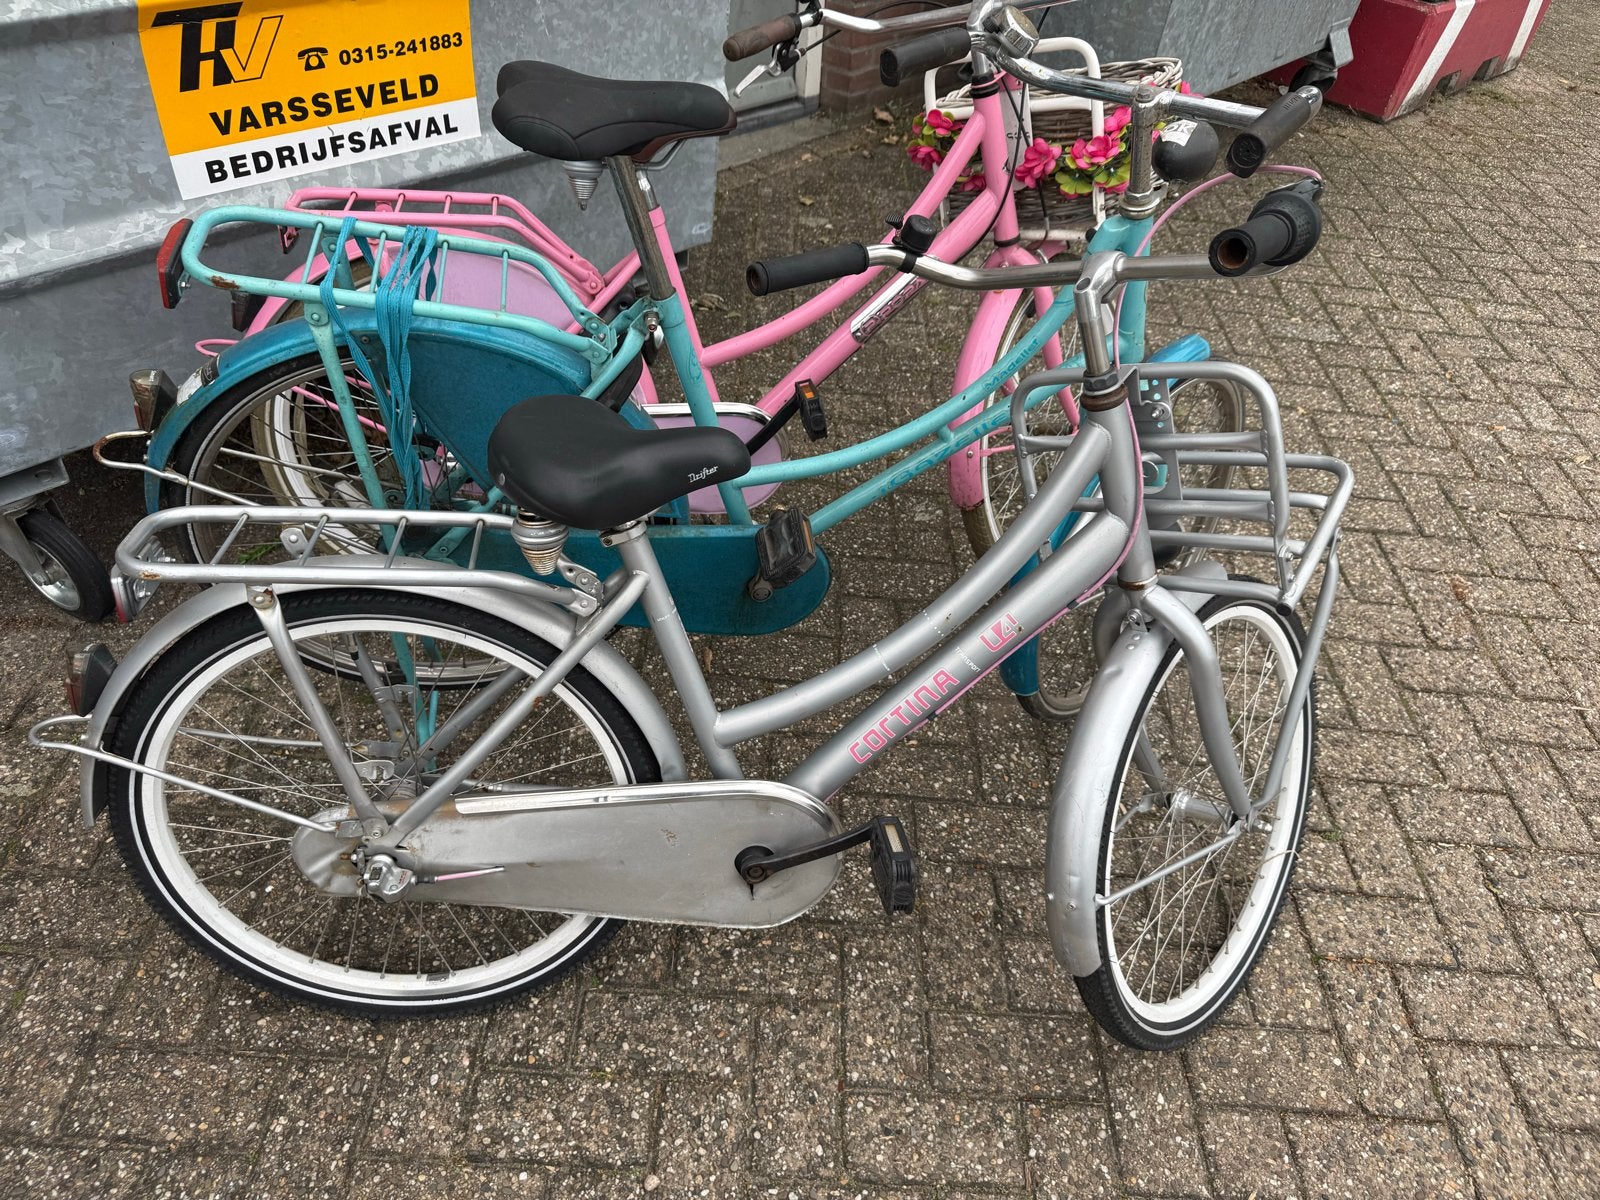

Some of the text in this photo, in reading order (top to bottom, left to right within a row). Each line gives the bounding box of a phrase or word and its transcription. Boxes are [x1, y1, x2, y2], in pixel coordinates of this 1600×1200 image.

[338, 32, 464, 66] 0315-241883
[209, 73, 440, 136] VARSSEVELD
[204, 113, 459, 185] BEDRIJFSAFVAL
[687, 465, 719, 483] Drifter
[848, 667, 960, 764] CORTINA
